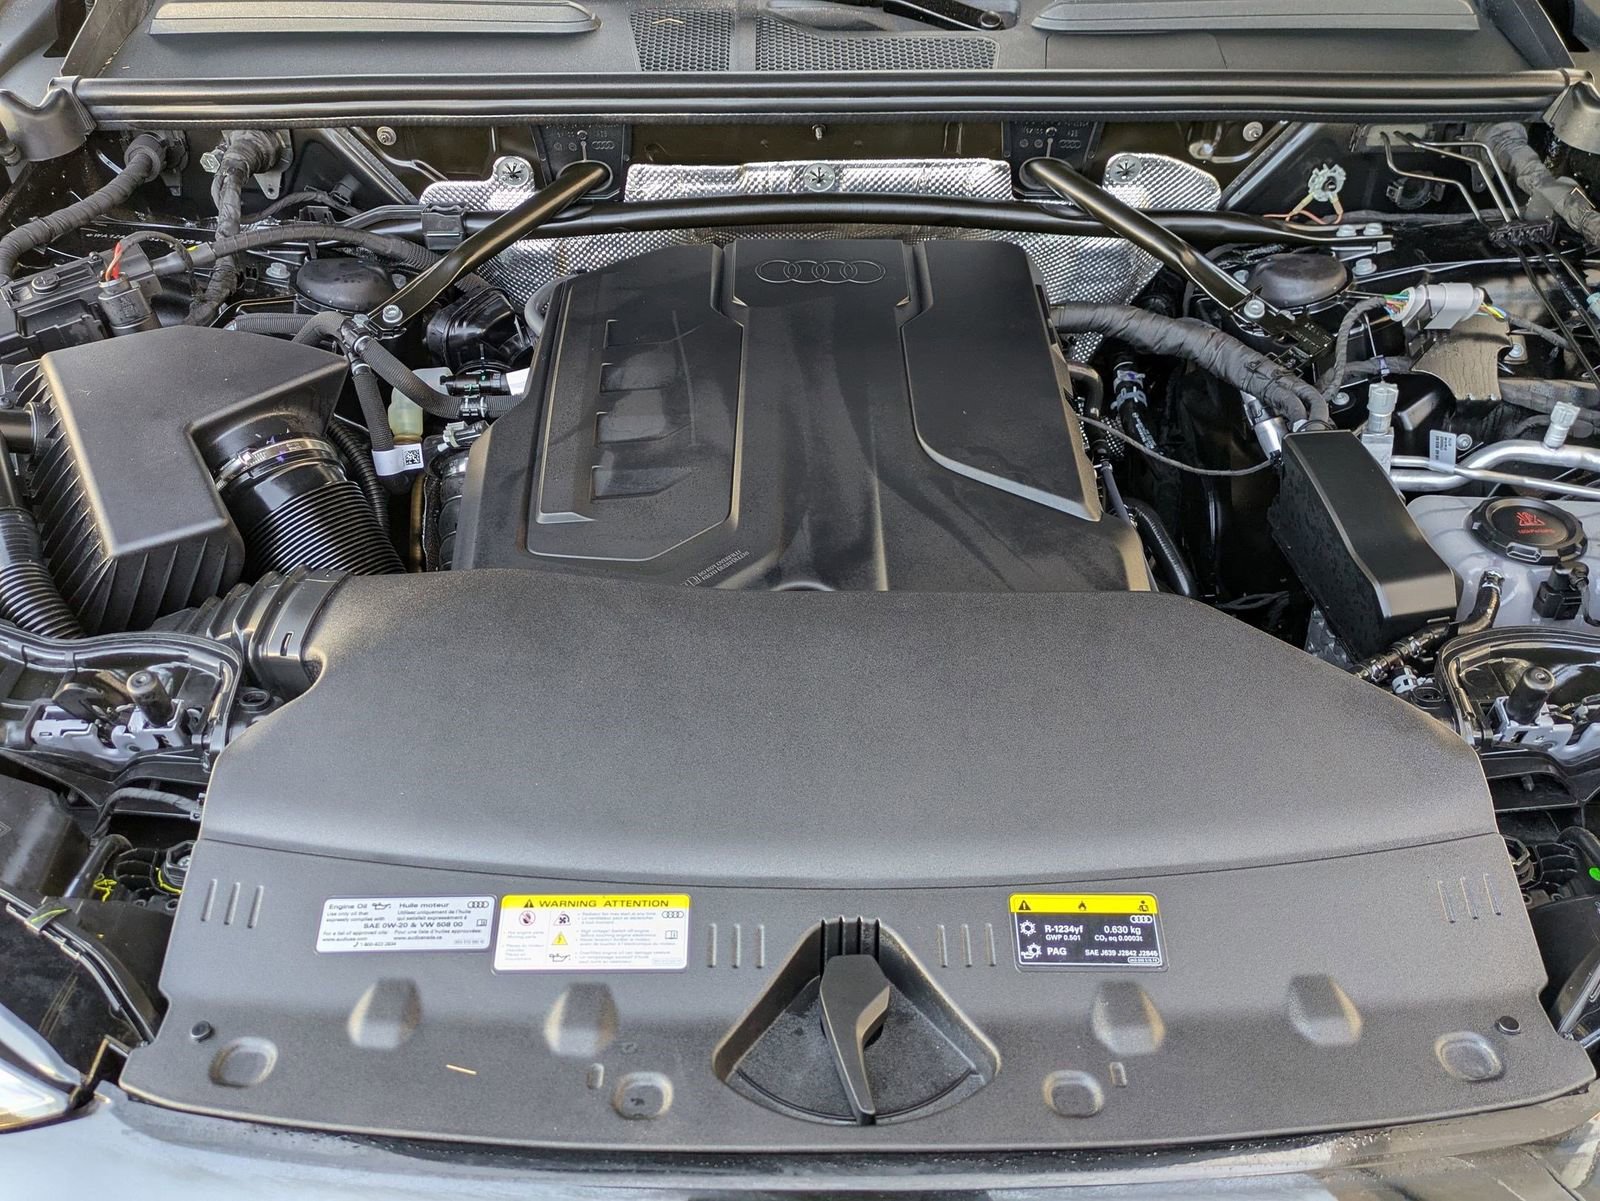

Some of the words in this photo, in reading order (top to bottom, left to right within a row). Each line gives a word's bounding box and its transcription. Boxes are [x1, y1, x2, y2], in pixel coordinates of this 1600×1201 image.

[1044, 924, 1084, 934] R-1234yf
[1130, 926, 1142, 935] kg
[1046, 947, 1067, 956] PAG
